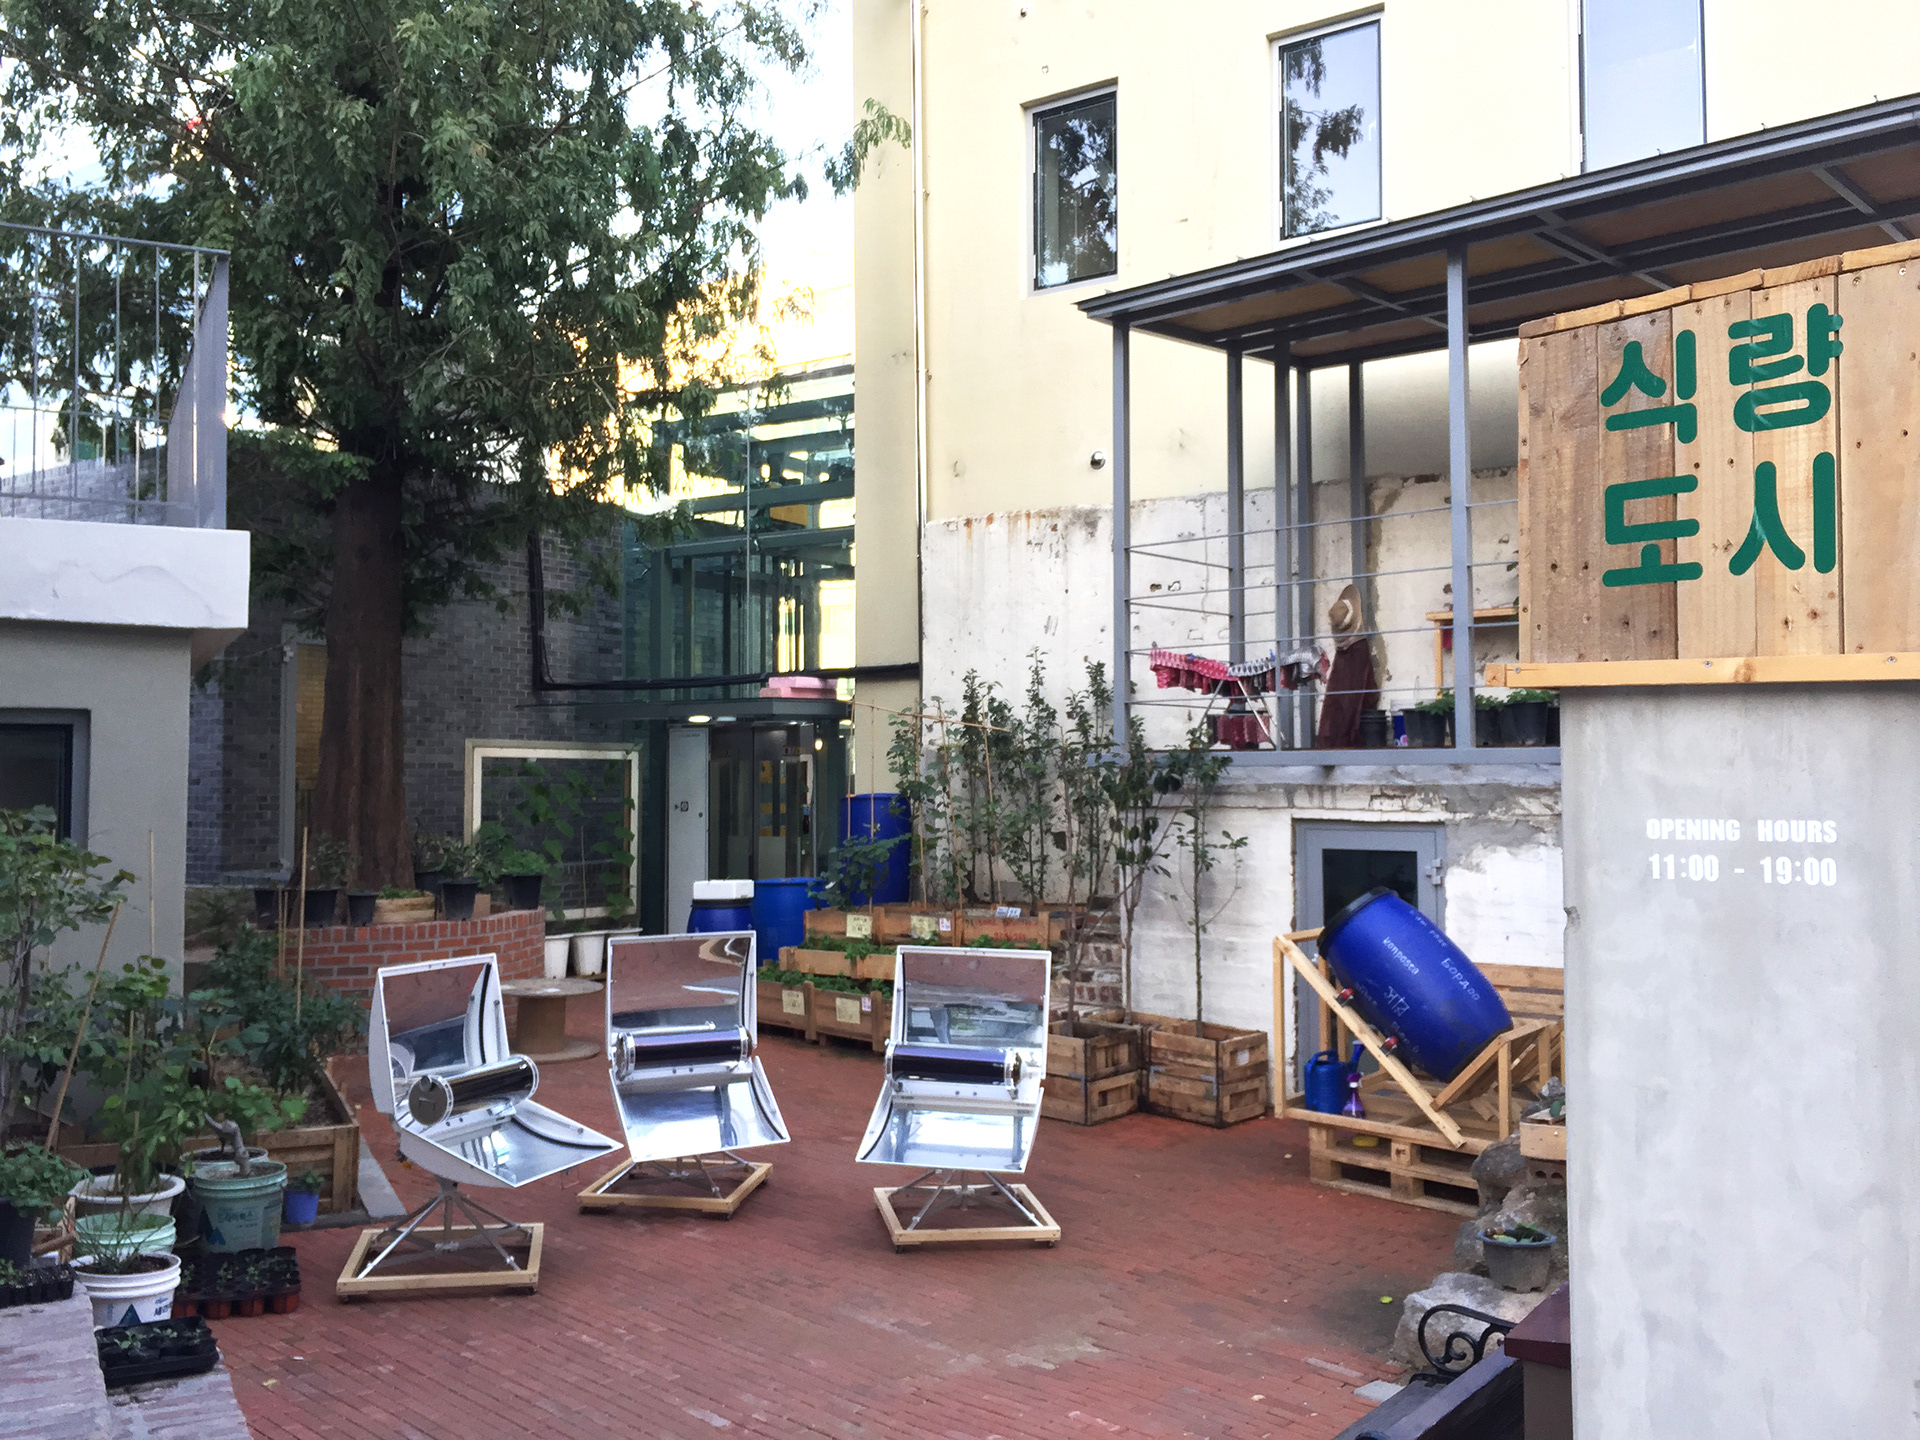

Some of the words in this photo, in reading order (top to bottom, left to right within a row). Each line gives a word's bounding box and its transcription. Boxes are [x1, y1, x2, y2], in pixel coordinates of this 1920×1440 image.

[1600, 303, 1844, 444] 식량
[1602, 452, 1836, 587] 도시
[1646, 818, 1741, 841] OPENING
[1757, 819, 1838, 843] HOURS
[1648, 853, 1720, 882] 11:00
[1759, 856, 1838, 887] 19:00
